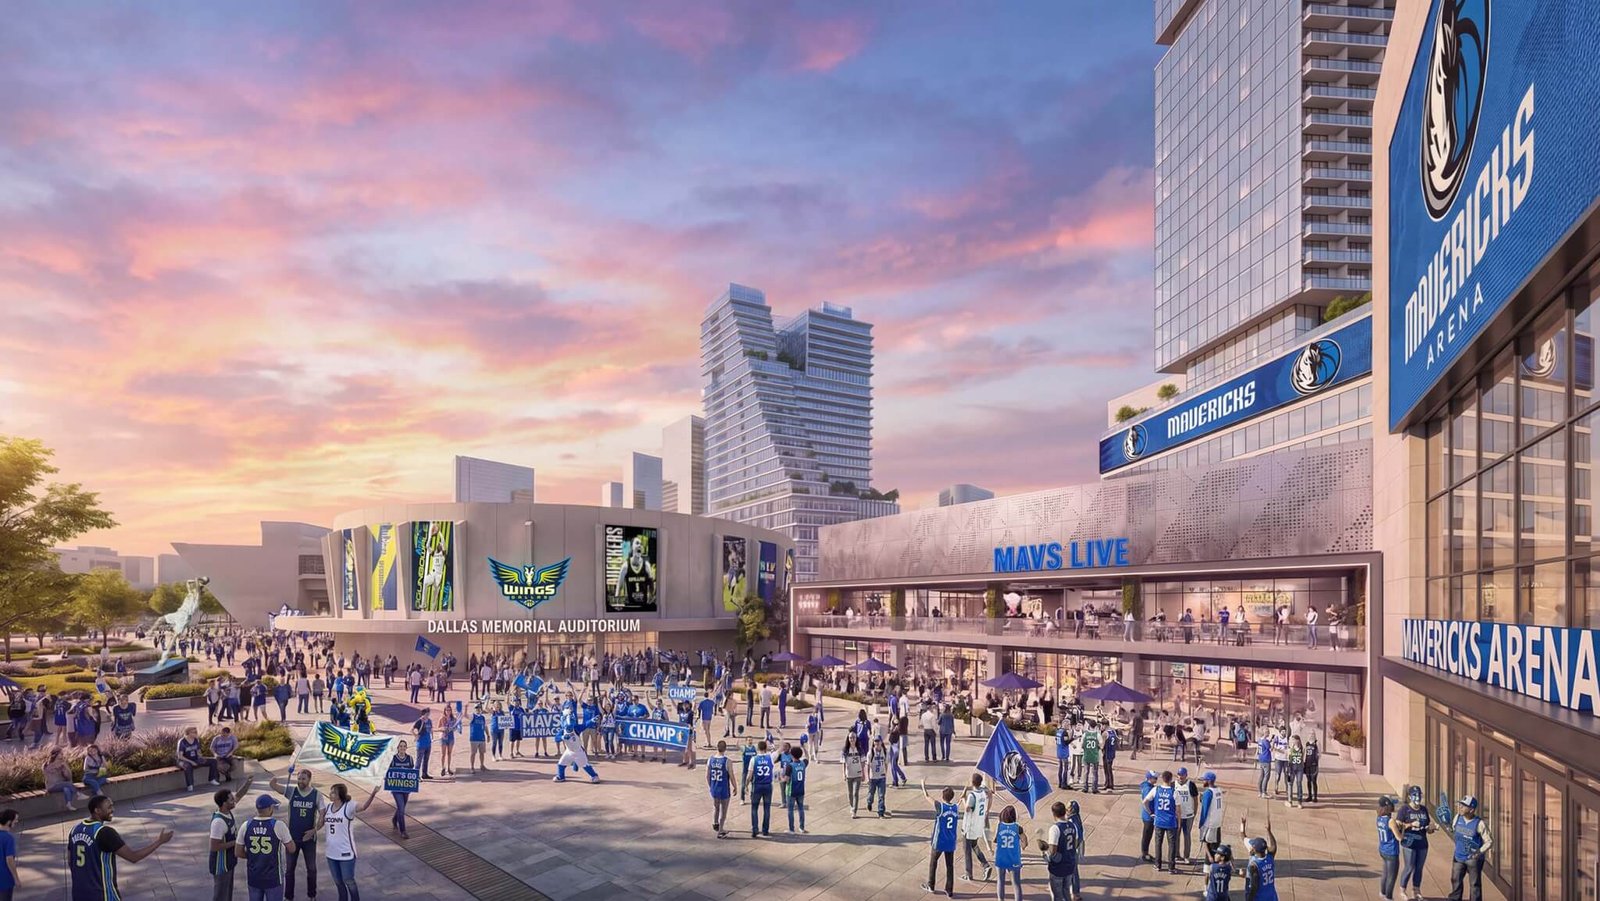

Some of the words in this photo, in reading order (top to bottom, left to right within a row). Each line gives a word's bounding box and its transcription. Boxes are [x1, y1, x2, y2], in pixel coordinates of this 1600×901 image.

[1404, 82, 1534, 366] MAVERICKS
[1426, 282, 1483, 371] ARENA
[1167, 380, 1256, 439] MAVERICKS
[994, 542, 1063, 573] MAVS
[1070, 537, 1130, 568] LIVE
[503, 584, 555, 595] WINGS
[428, 620, 478, 633] DALLAS
[482, 620, 555, 633] MEMORIAL
[558, 619, 640, 633] AUDITORIUM
[1402, 619, 1481, 681] MAVERICKS
[1486, 624, 1600, 718] ARENA
[669, 688, 697, 699] CHAMP
[522, 714, 560, 728] MAVS
[629, 723, 676, 741] CHAMP
[1086, 740, 1096, 748] 20
[323, 743, 369, 766] WINGS
[388, 771, 406, 779] LET'S
[407, 772, 417, 780] GO
[711, 769, 723, 781] 32
[757, 766, 771, 777] 32
[797, 771, 803, 781] 0
[387, 780, 417, 788] WINGS!
[979, 805, 985, 816] 2
[1158, 799, 1170, 811] 32
[329, 824, 335, 834] 5
[946, 817, 953, 829] 2
[249, 836, 273, 854] 35
[1001, 835, 1015, 848] 32
[1066, 835, 1073, 850] 2
[76, 844, 86, 867] 5
[1262, 871, 1274, 886] 32
[1215, 880, 1224, 893] 11
